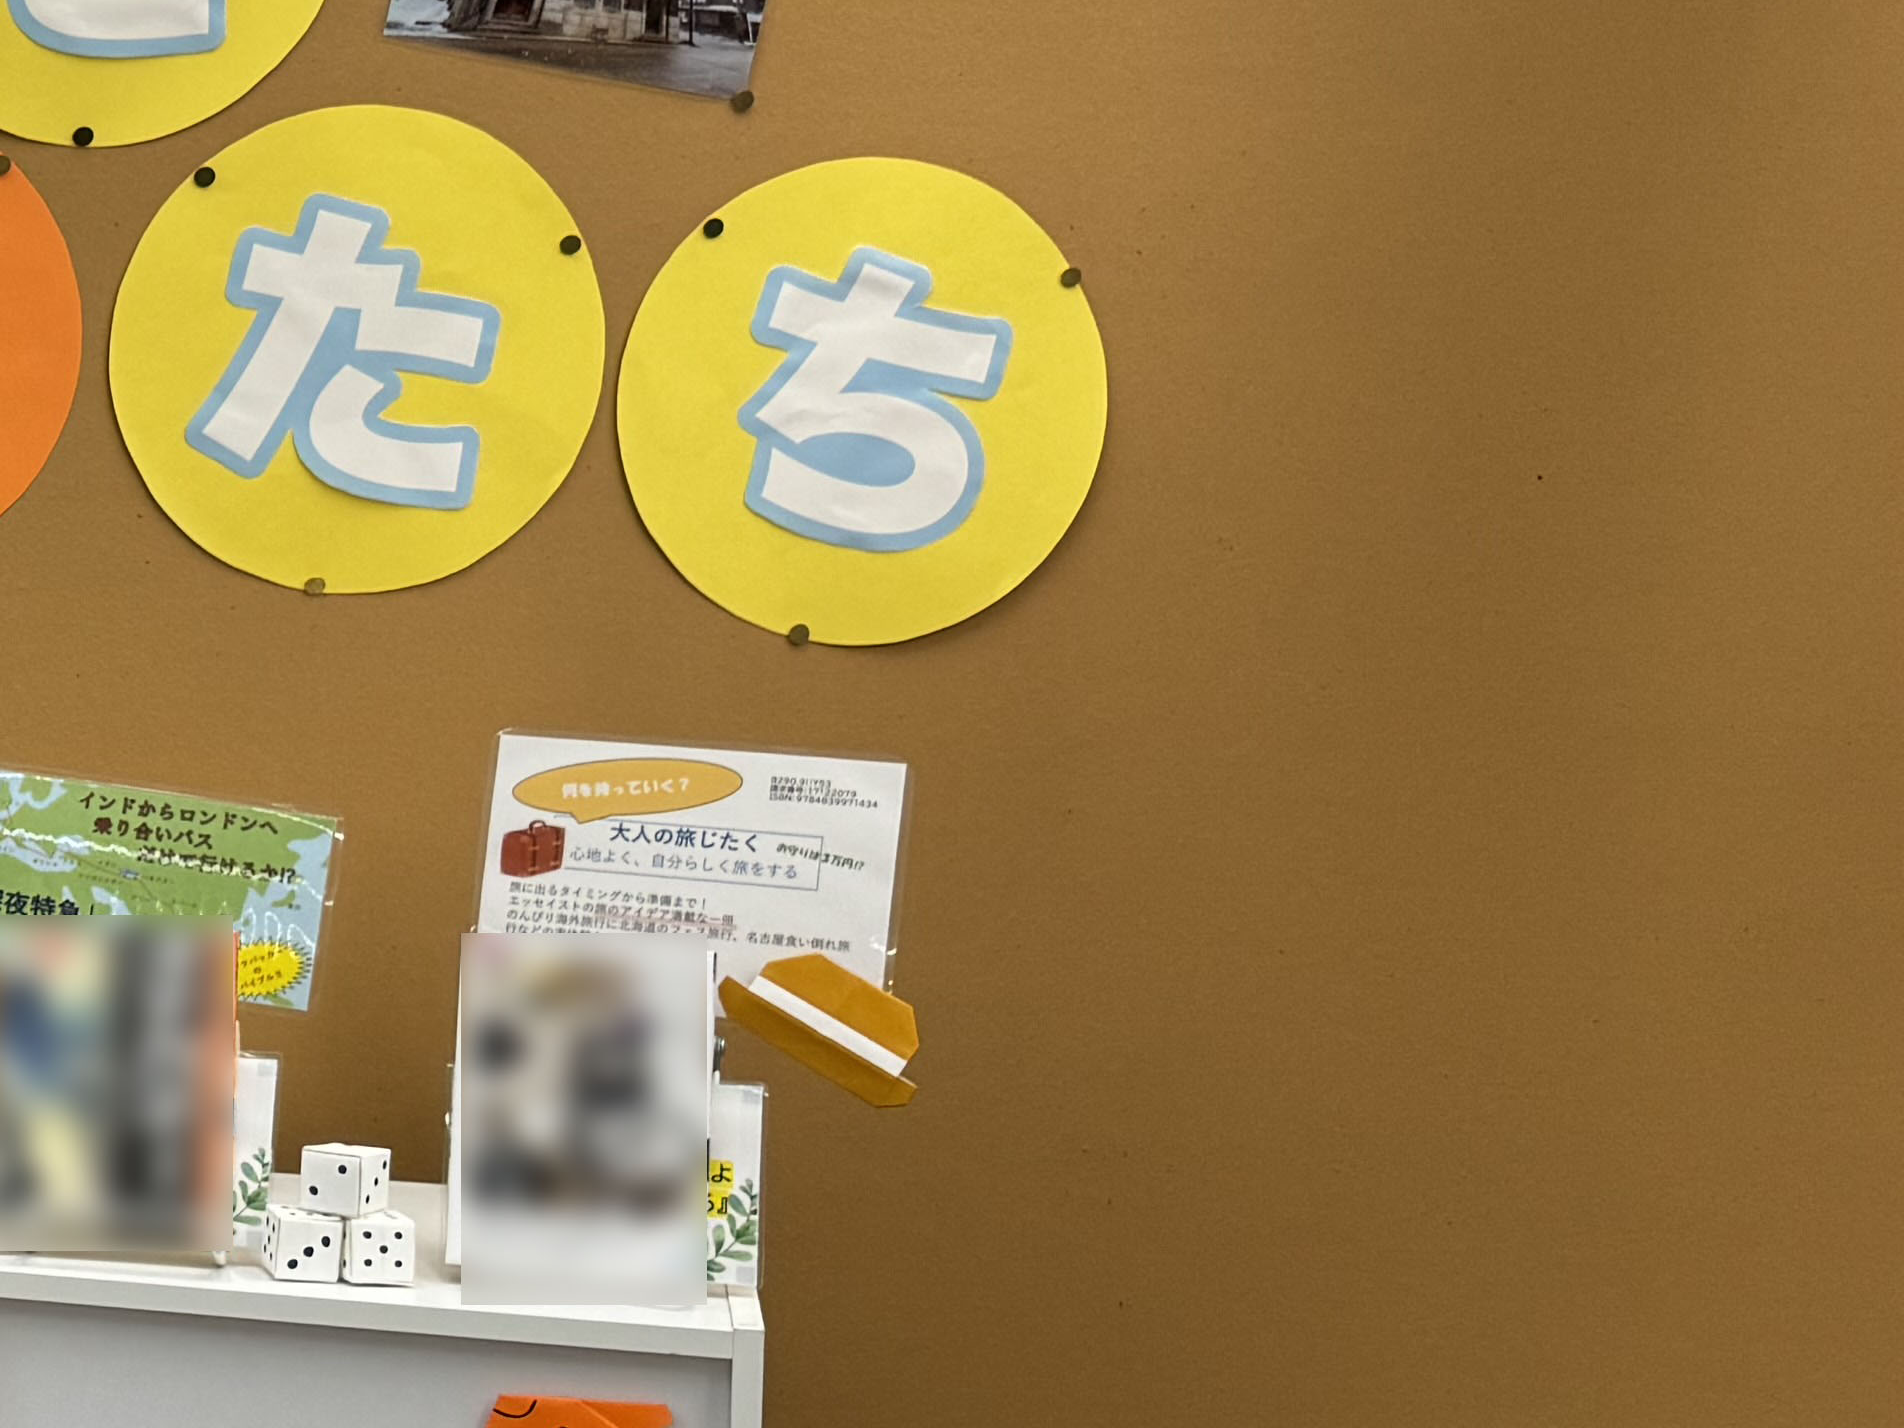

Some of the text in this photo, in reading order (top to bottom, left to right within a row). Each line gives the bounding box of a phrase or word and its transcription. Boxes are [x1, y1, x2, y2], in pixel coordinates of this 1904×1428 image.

[80, 792, 279, 835] インドからロンドンへ
[92, 817, 213, 850] 乗り合いバス
[610, 821, 758, 853] 大人の旅じたく
[570, 847, 798, 879] 心地よく、自分らしく旅をする
